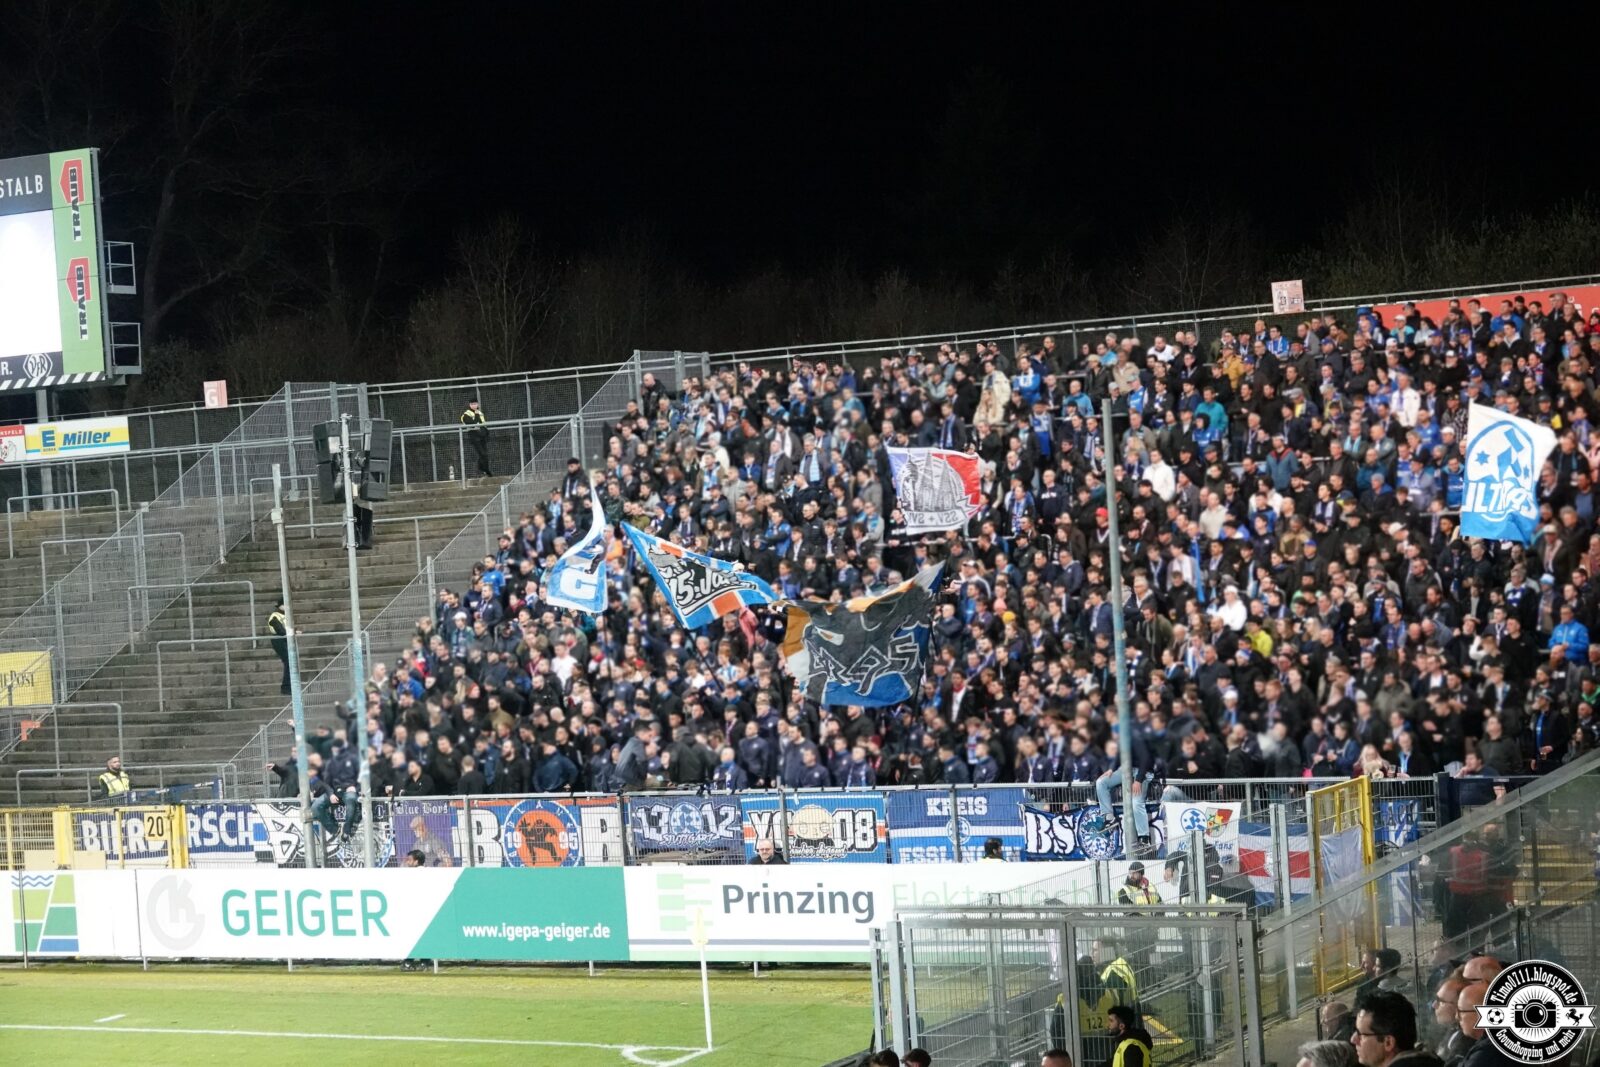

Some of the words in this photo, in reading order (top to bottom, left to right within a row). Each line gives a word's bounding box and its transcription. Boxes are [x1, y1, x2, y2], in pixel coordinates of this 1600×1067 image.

[69, 167, 81, 241] TRAUB
[76, 266, 88, 340] TRAUB
[42, 430, 56, 447] E
[63, 430, 111, 447] Miller
[422, 802, 449, 815] Boys
[926, 796, 988, 816] KREIS
[147, 816, 165, 838] 20
[660, 832, 717, 846] STUTTGART
[222, 889, 390, 937] GEIGER
[723, 882, 874, 924] Prinzing
[462, 922, 611, 942] www.igepa-geiger.de
